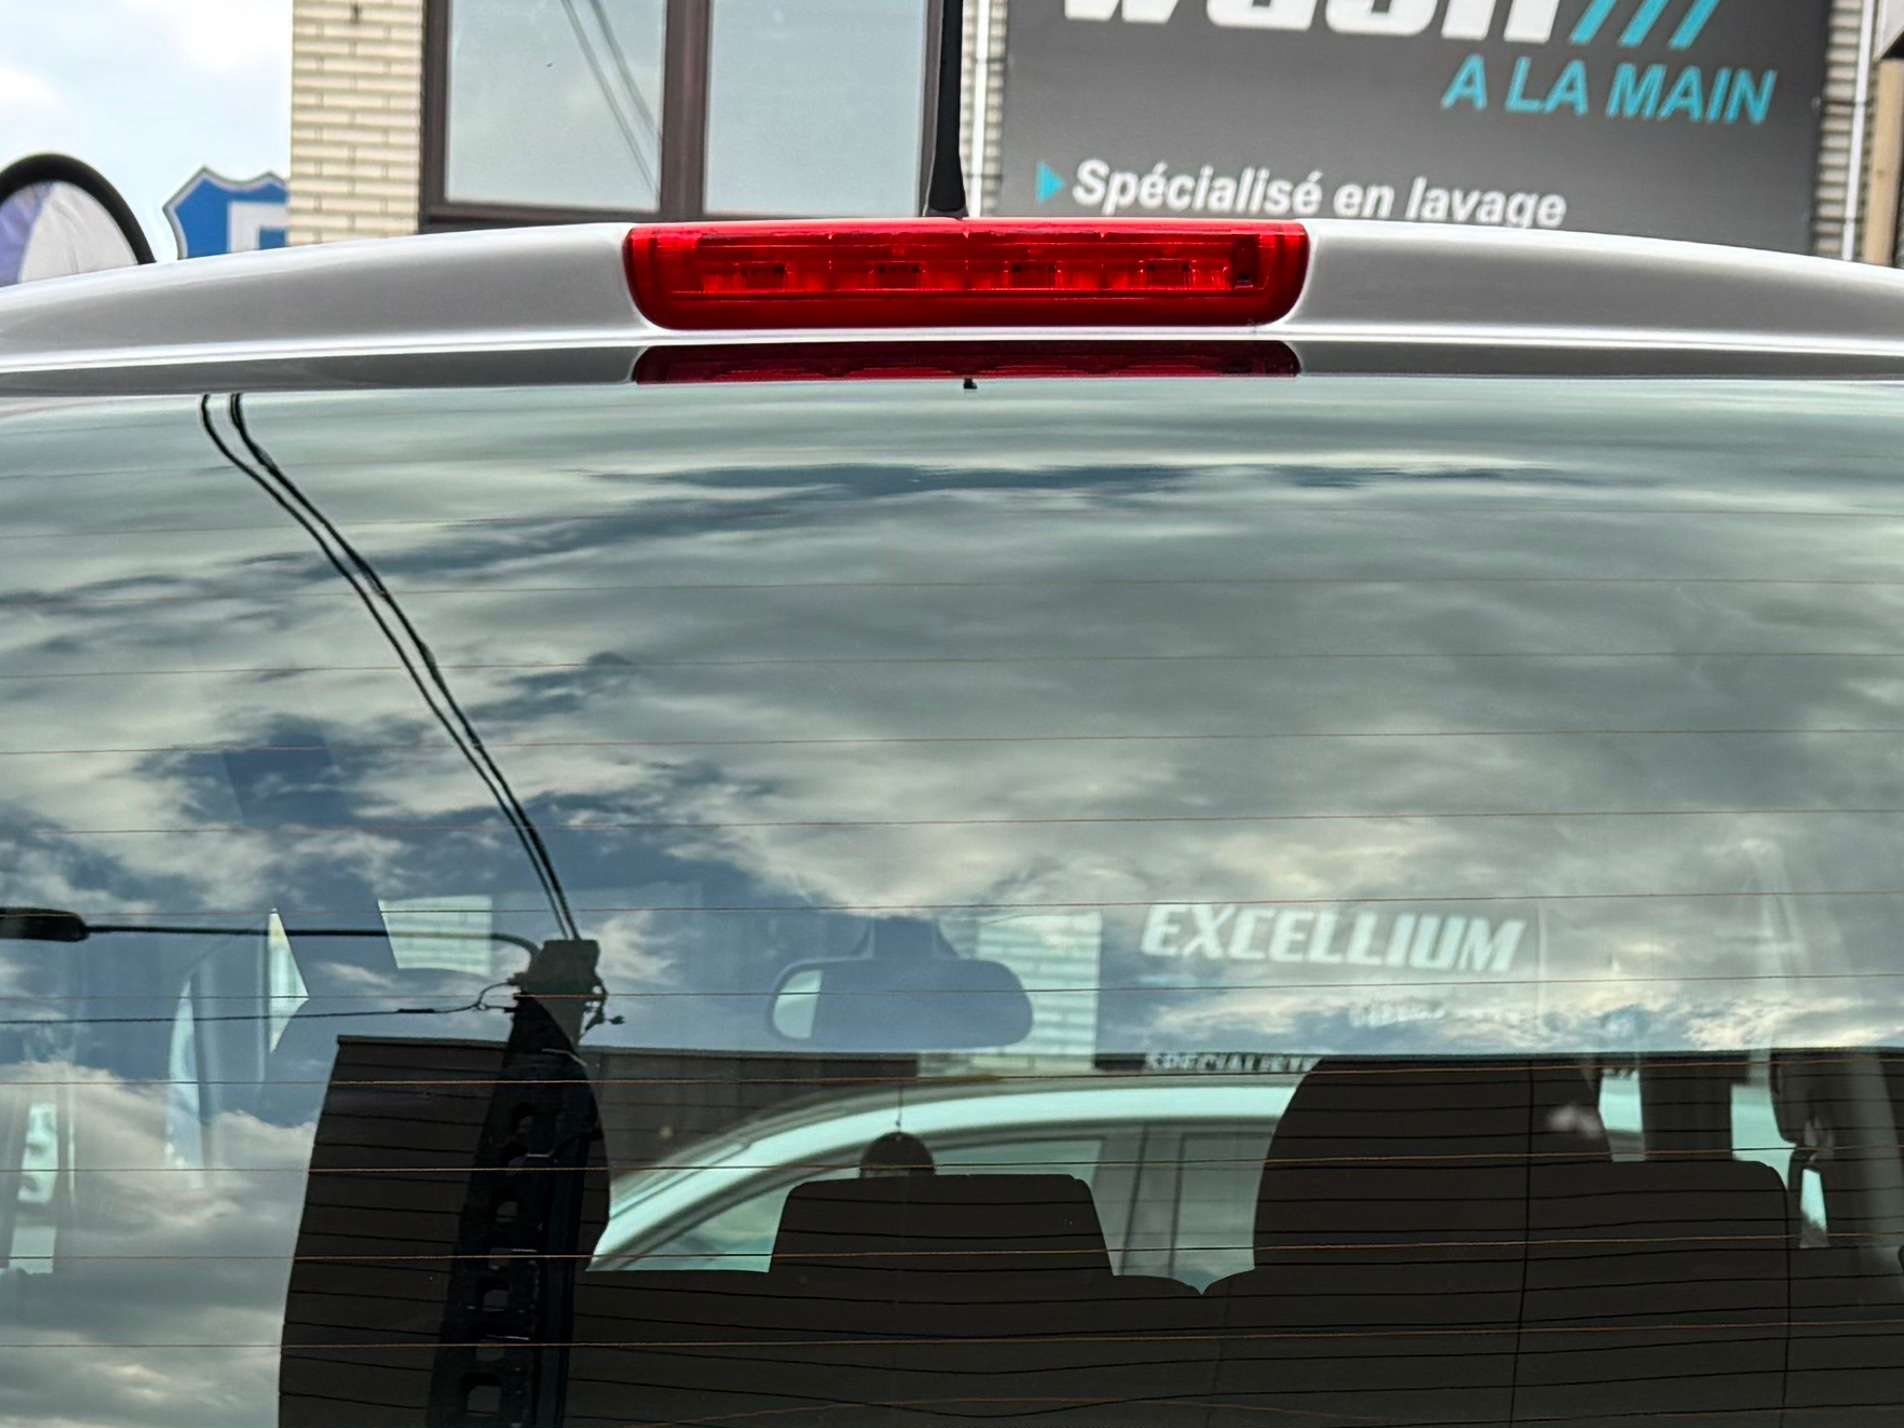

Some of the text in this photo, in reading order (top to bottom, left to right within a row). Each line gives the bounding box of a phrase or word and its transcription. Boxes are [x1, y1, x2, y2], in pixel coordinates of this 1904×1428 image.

[1442, 54, 1778, 125] A LA MAIN
[1072, 160, 1566, 228] Spécialisé en lavage
[1140, 902, 1528, 973] EXCELLIUM
